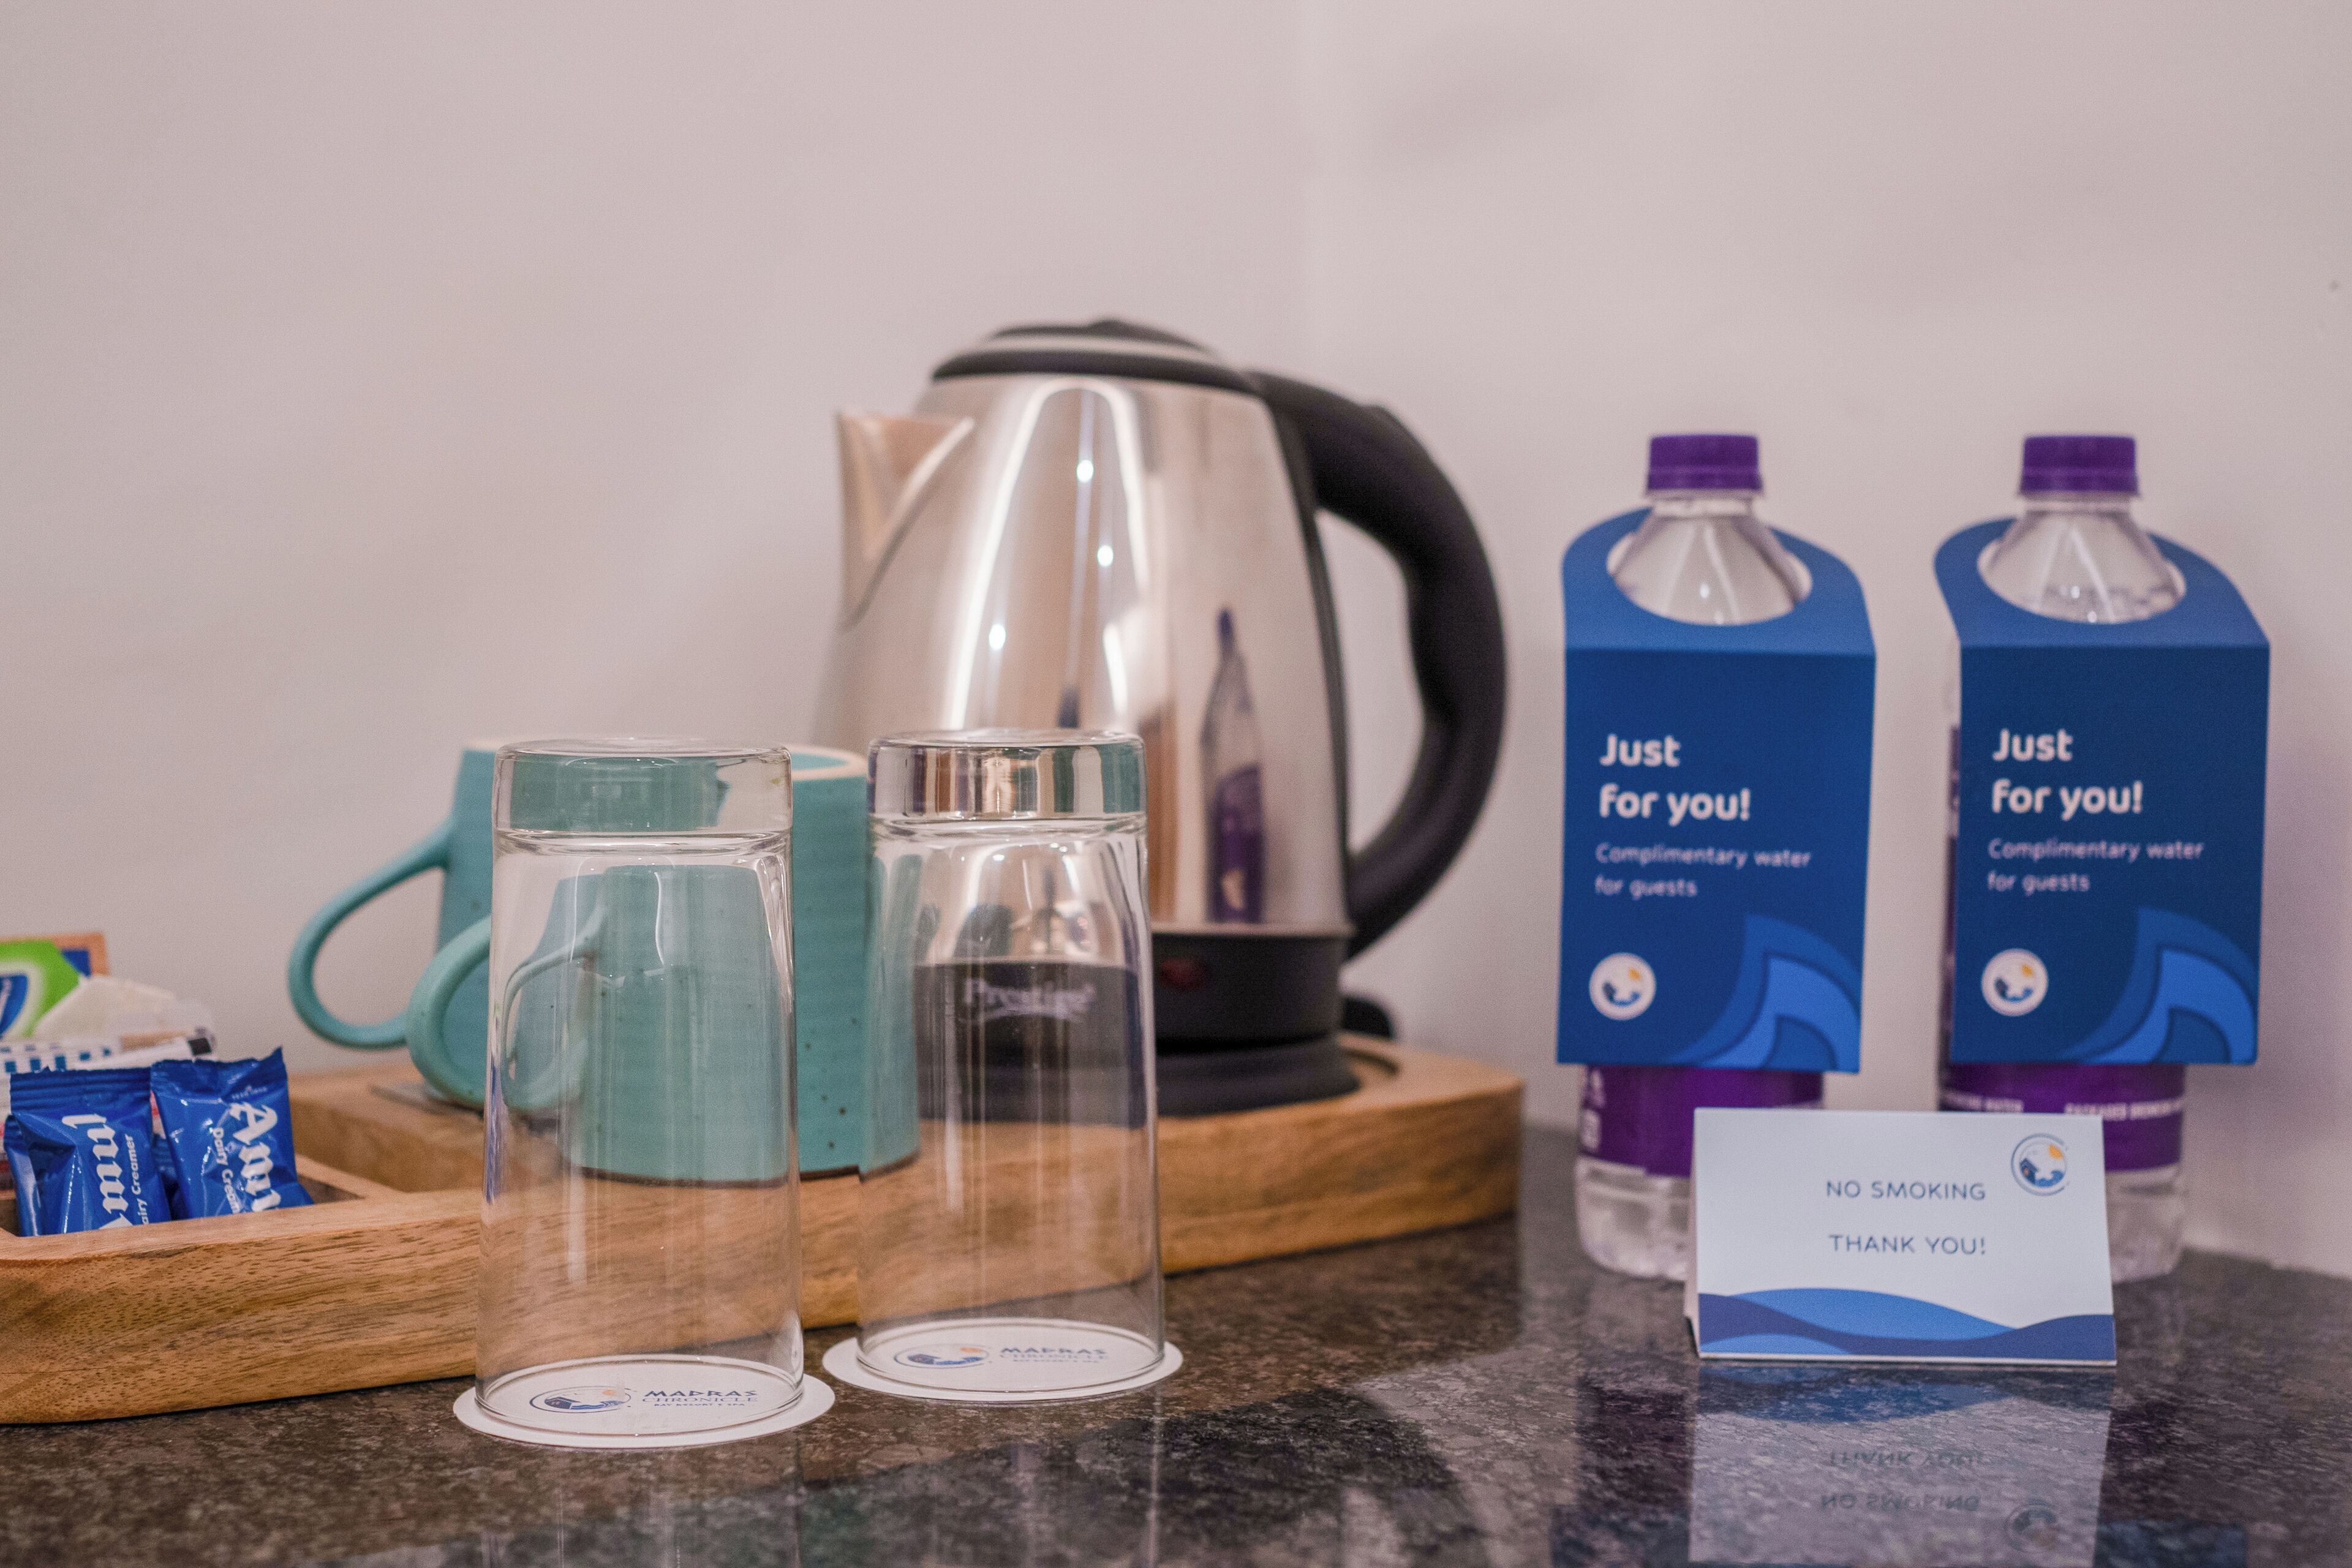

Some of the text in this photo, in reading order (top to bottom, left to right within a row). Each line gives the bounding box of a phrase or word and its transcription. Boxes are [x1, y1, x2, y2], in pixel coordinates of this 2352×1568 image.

[1600, 734, 1680, 767] Just
[1992, 729, 2073, 761] Just
[1599, 783, 1751, 826] for you!
[1991, 778, 2143, 821] for you!
[1596, 843, 1811, 869] Complimentary water
[1988, 838, 2204, 862] Complimentary water
[1594, 875, 1698, 900] for guests
[1987, 871, 2090, 896] for guests
[213, 1126, 228, 1166] Dairy
[124, 1133, 149, 1224] airy Creamer
[1825, 1180, 1986, 1201] NO SMOKING
[1828, 1234, 1986, 1255] THANK YOU!
